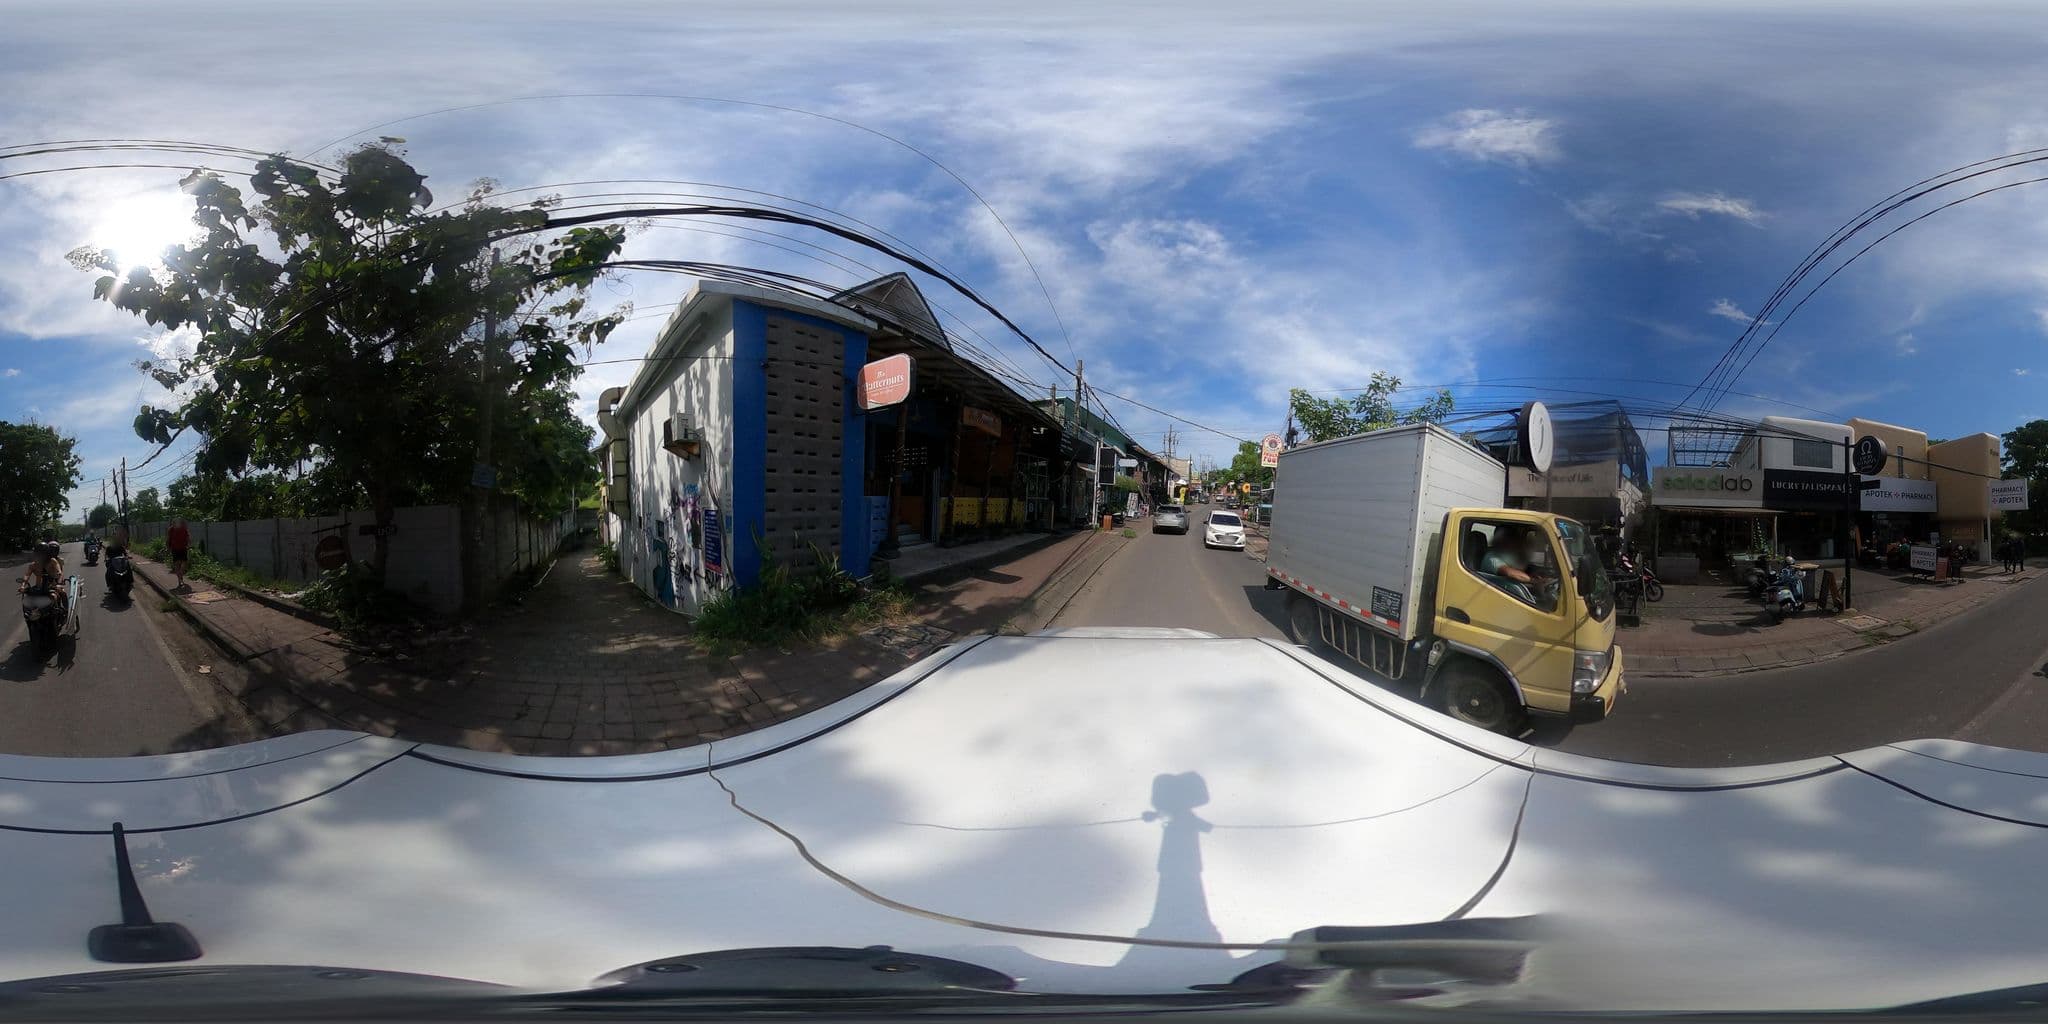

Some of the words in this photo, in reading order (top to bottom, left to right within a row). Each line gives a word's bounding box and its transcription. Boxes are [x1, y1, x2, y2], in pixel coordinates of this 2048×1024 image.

[1771, 480, 1799, 490] LUCKY
[1991, 486, 2025, 494] PHARMACY
[1865, 490, 1893, 498] APOTEK
[1901, 491, 1935, 501] PHARMACY
[1999, 496, 2025, 504] APOTEK
